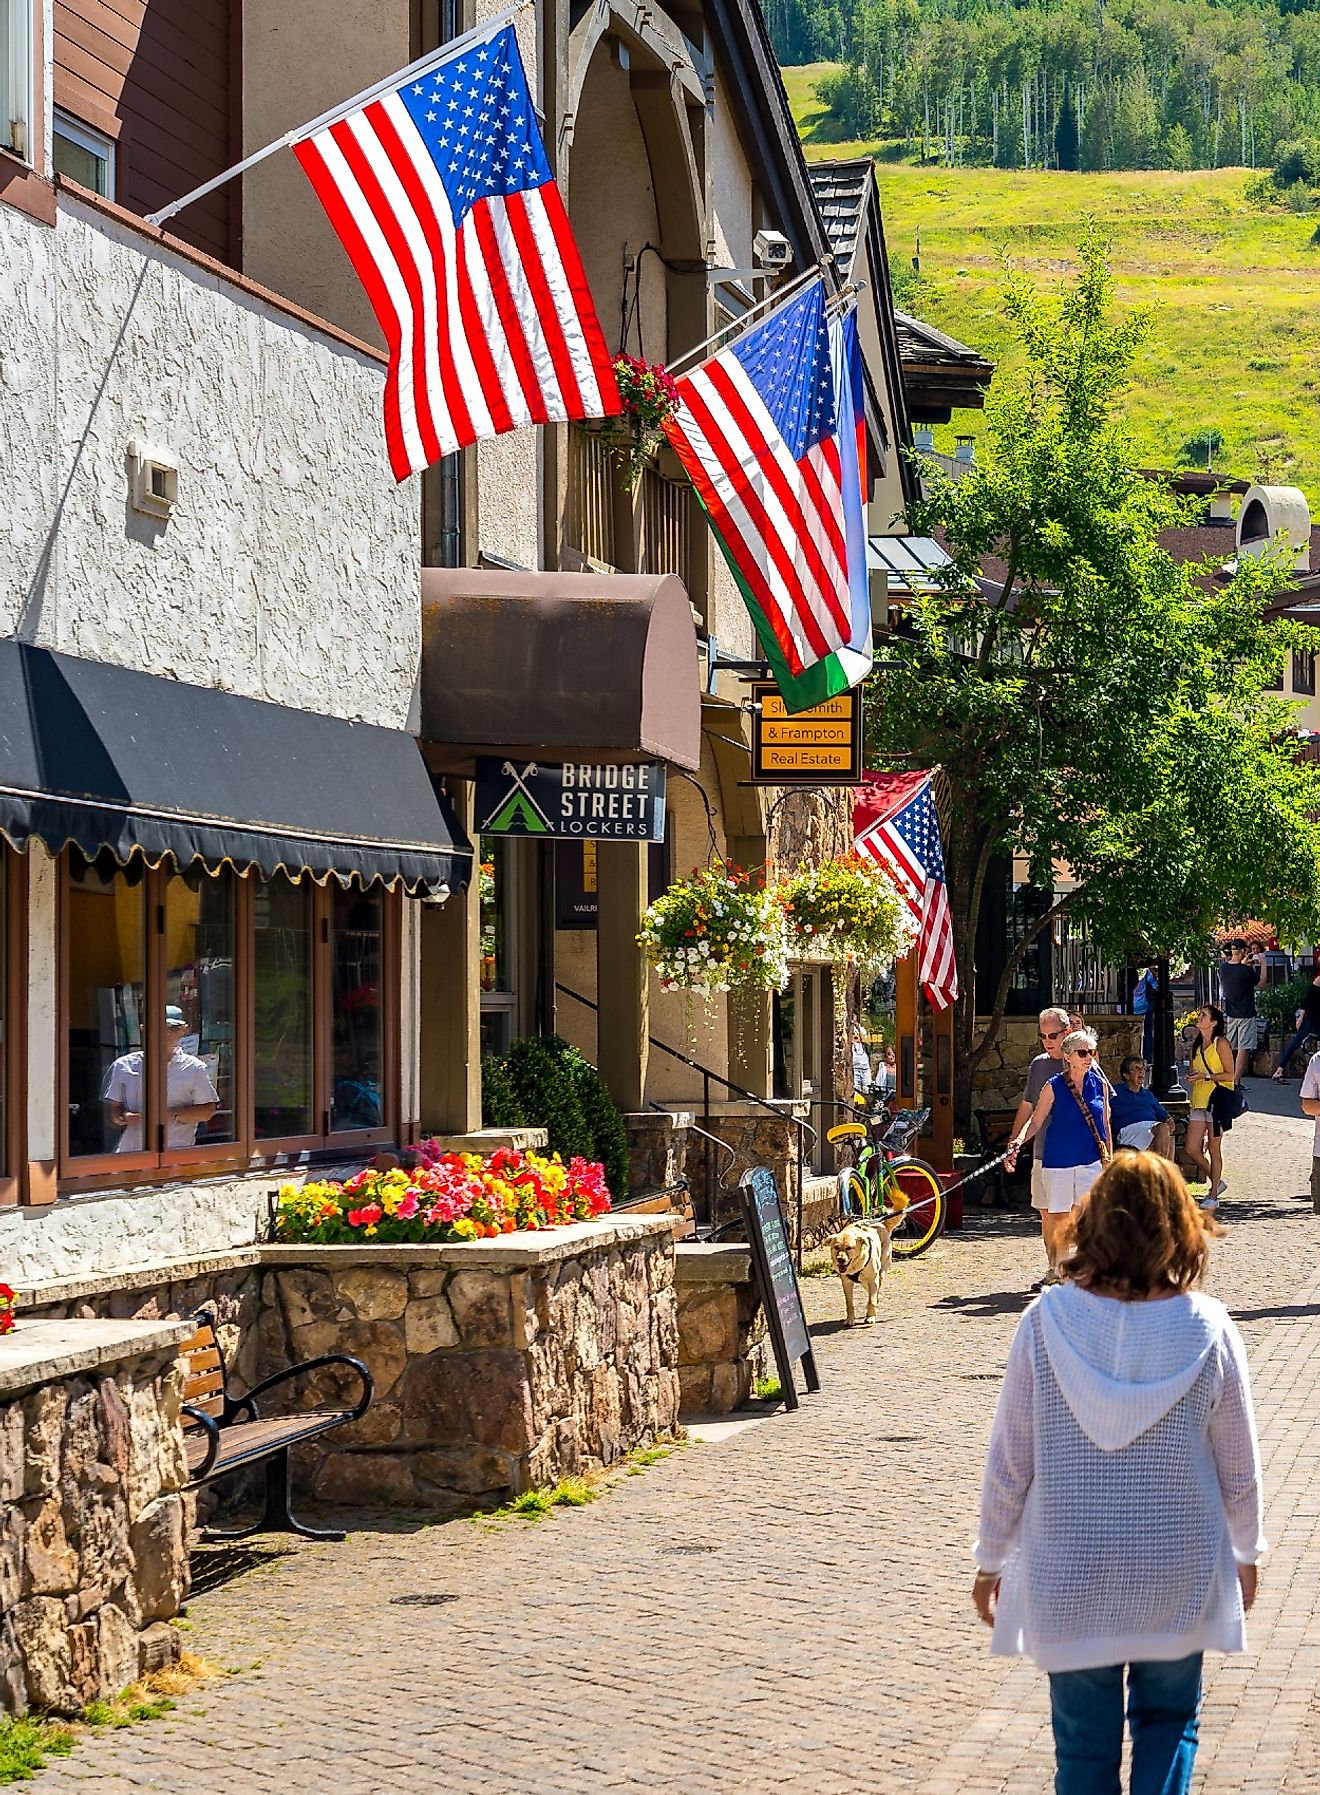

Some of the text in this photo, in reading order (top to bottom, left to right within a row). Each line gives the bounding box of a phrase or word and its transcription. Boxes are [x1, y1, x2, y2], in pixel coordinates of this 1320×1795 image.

[768, 727, 844, 741] & Frampton
[771, 752, 841, 765] Real Estate
[561, 763, 649, 790] BRIDGE
[560, 792, 649, 819] STREET
[561, 821, 648, 836] LOCKERS
